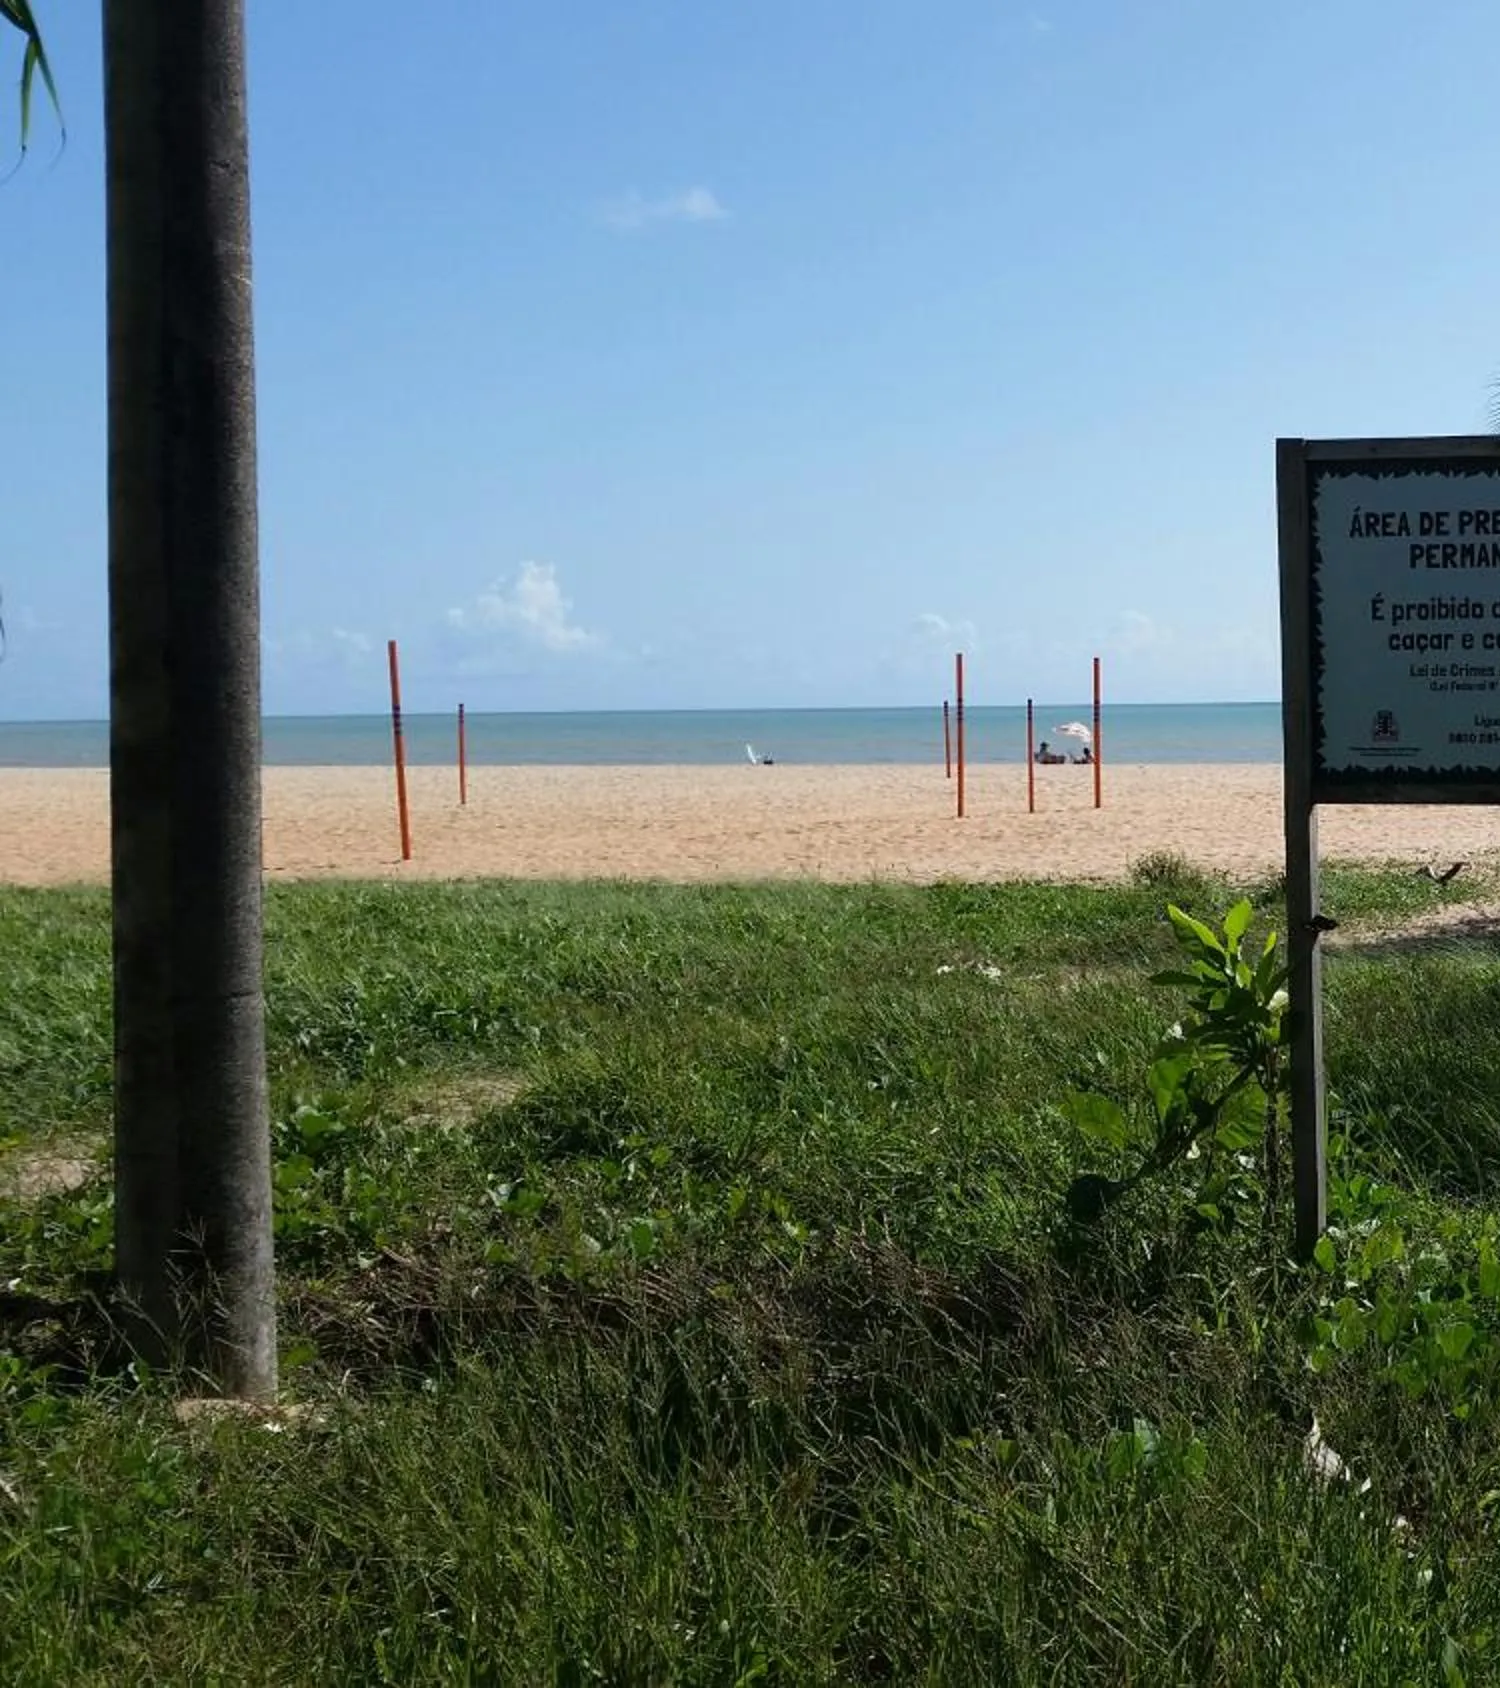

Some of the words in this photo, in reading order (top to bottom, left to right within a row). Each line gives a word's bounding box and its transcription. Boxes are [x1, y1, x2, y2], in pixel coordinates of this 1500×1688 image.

[1350, 506, 1411, 538] ÁREA
[1419, 511, 1450, 537] DE
[1371, 593, 1385, 621] É
[1392, 597, 1484, 626] proibido
[1388, 632, 1453, 653] caçar
[1461, 633, 1474, 650] e
[1409, 663, 1429, 676] Lei
[1431, 663, 1447, 676] de
[1450, 663, 1494, 676] Crimes
